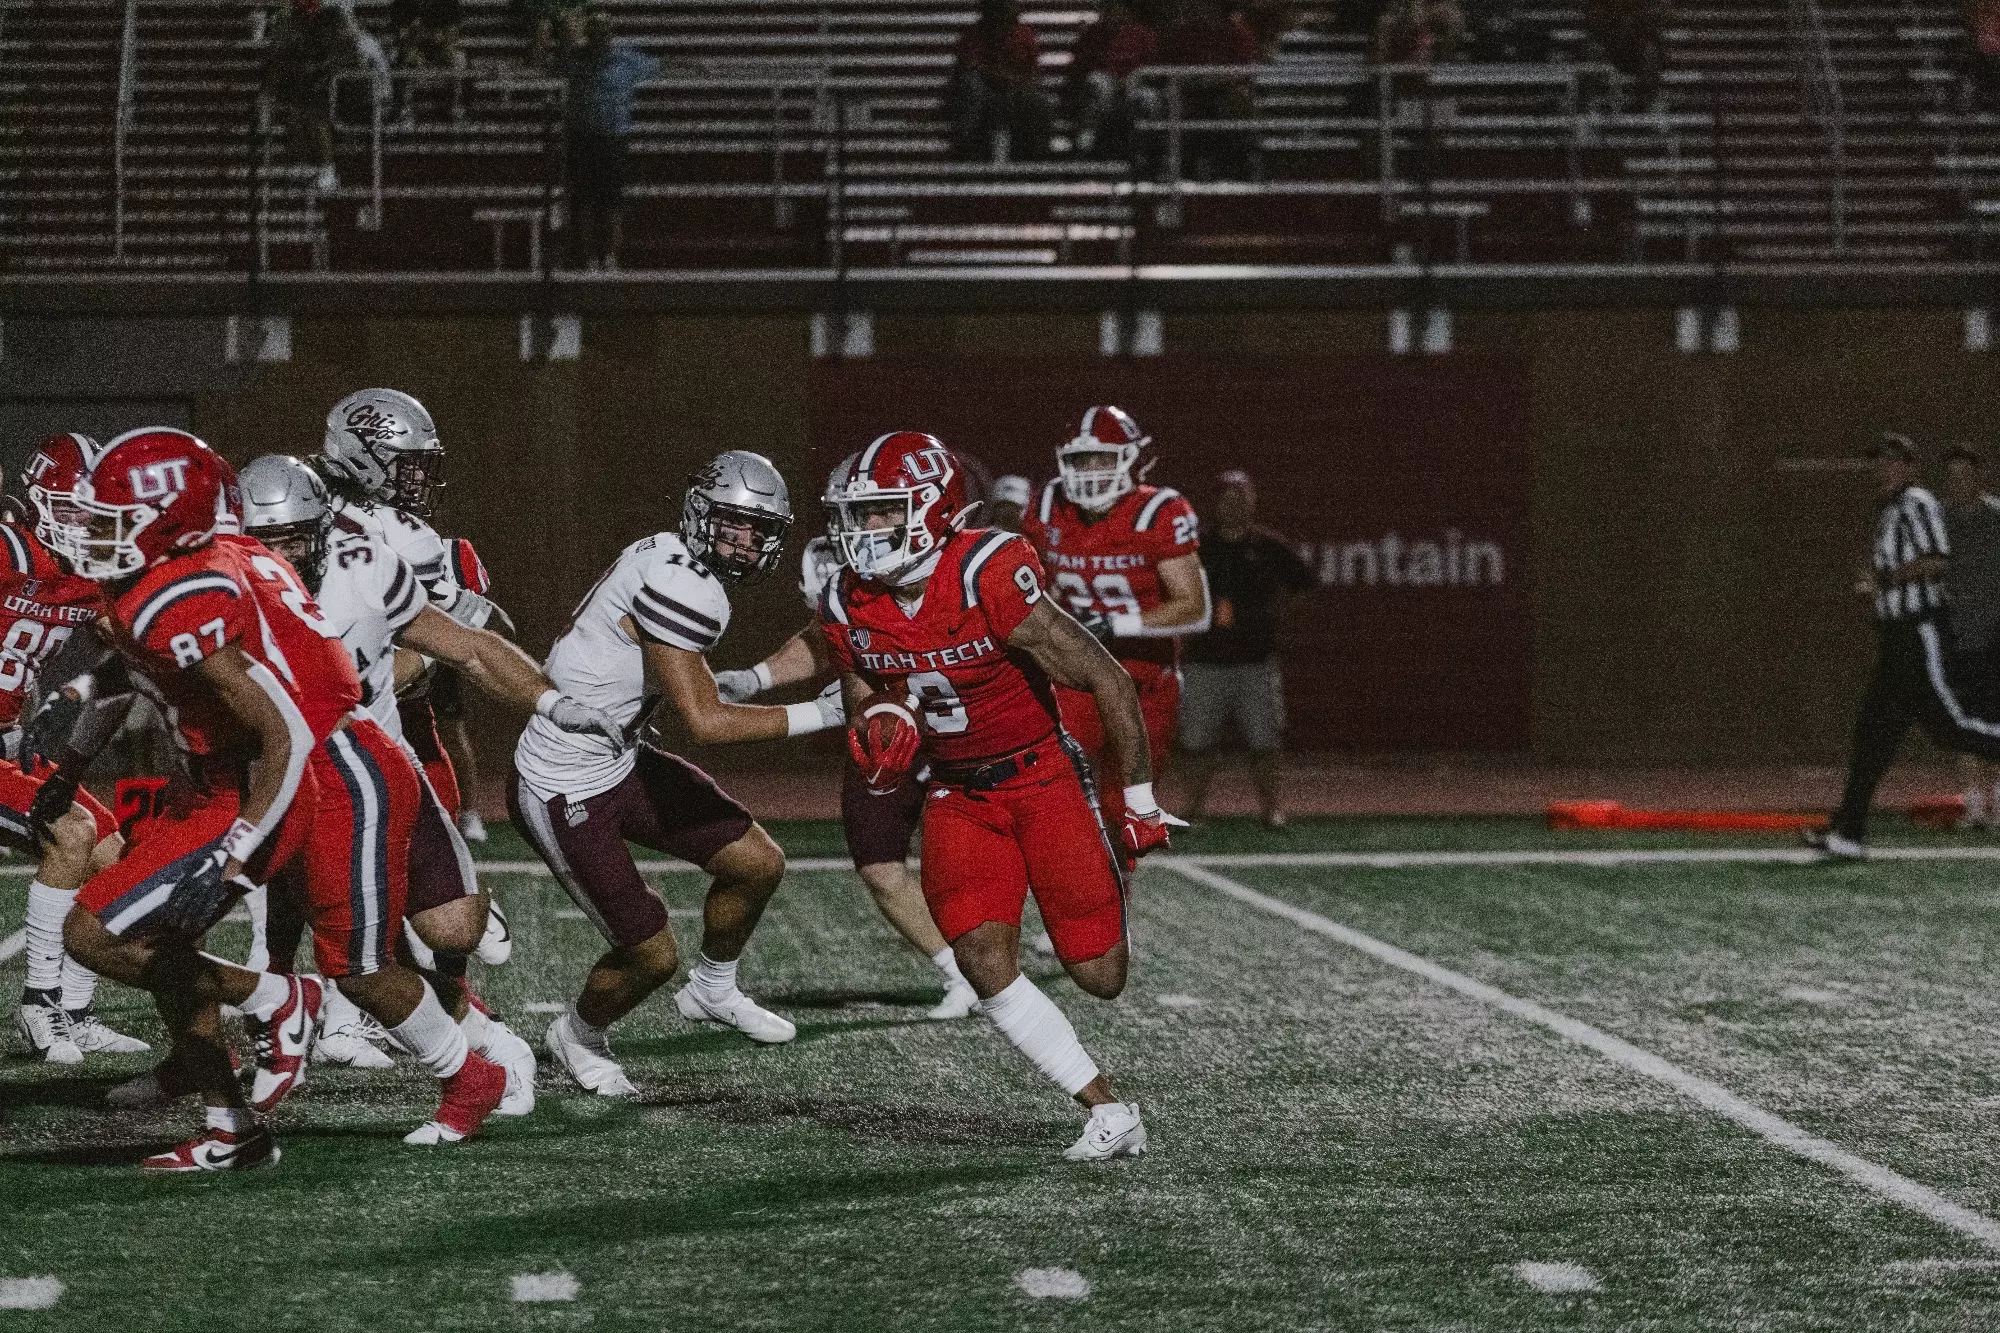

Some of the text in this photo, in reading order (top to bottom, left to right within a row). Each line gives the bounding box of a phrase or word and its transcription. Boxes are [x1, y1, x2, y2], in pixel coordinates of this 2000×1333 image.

[128, 457, 190, 500] UT
[1298, 531, 1502, 583] untain
[1012, 563, 1043, 606] 9
[3, 595, 55, 618] UTAH
[168, 616, 226, 670] 87
[921, 635, 995, 669] TECH
